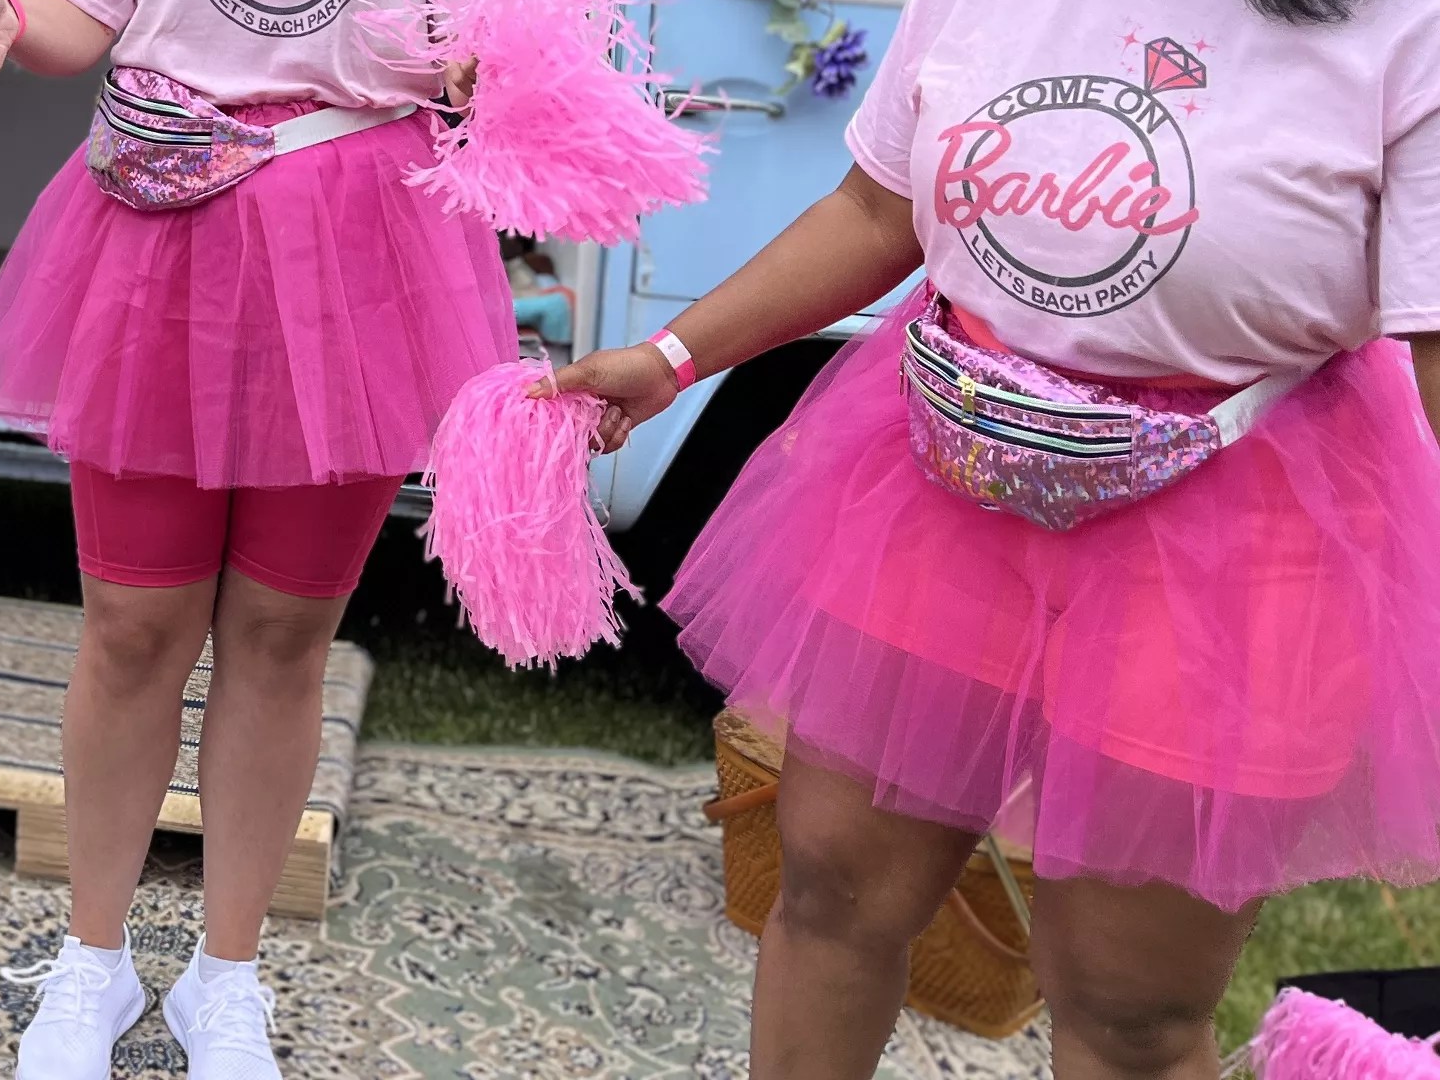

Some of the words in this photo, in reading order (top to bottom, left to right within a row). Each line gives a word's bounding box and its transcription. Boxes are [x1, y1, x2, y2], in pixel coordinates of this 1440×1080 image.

[258, 18, 305, 33] BACH
[987, 76, 1106, 122] COME
[1112, 87, 1172, 135] ON
[933, 121, 1200, 236] Barbie
[971, 233, 1027, 296] LET'S
[1030, 282, 1091, 312] BACH
[1096, 249, 1161, 312] PARTY
